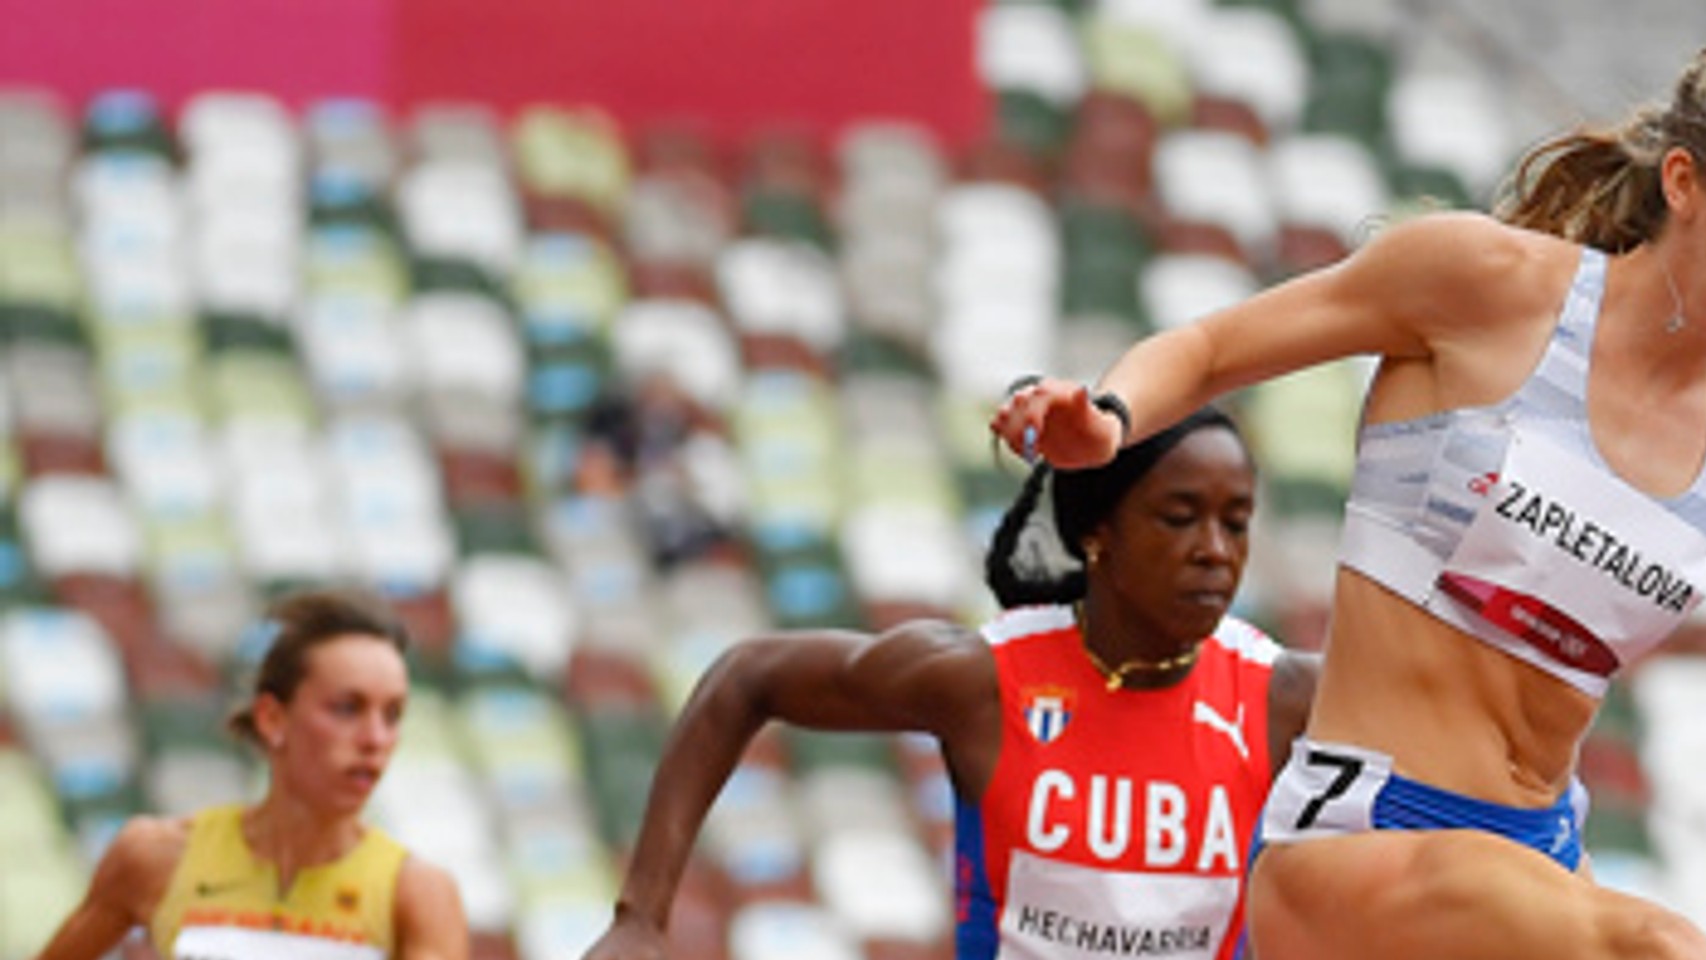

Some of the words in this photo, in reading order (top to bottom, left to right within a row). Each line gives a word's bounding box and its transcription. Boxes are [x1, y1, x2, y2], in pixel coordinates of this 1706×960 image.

[1495, 481, 1694, 613] ZAPLETALOVA
[1026, 768, 1240, 871] CUBA
[1296, 751, 1365, 829] 7
